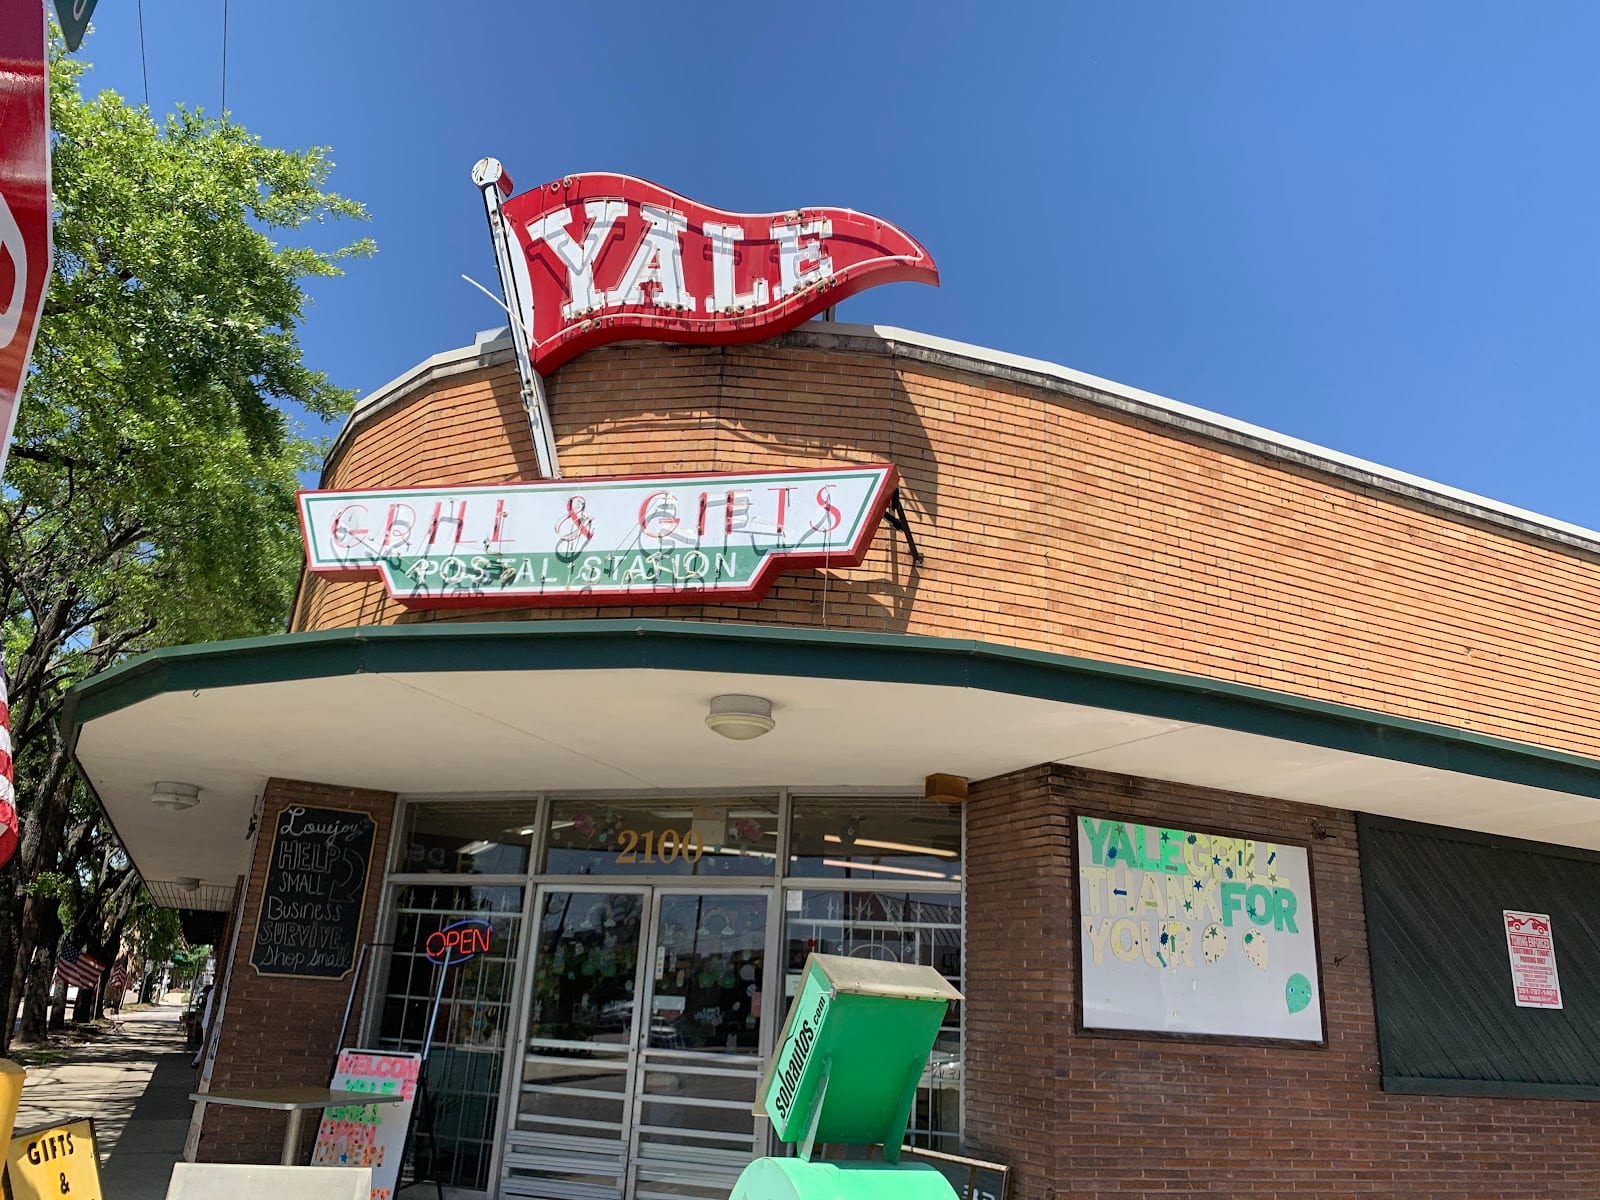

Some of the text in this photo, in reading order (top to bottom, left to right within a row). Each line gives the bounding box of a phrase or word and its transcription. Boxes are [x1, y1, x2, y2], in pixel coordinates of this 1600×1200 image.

[524, 198, 834, 319] YALE
[555, 494, 595, 542] &
[638, 484, 842, 538] GIFTS
[414, 551, 737, 585] POSTAL STATION
[278, 840, 341, 874] HELP
[614, 829, 705, 864] 2100
[1080, 815, 1187, 875] YALE
[278, 871, 325, 896] SMALL
[1080, 866, 1299, 934] THANK FOR
[267, 896, 342, 921] Business
[260, 945, 305, 972] Shop
[426, 927, 493, 957] OPEN
[1081, 916, 1196, 969] YOUR
[26, 1131, 74, 1166] GIFTS
[60, 1171, 70, 1195] &
